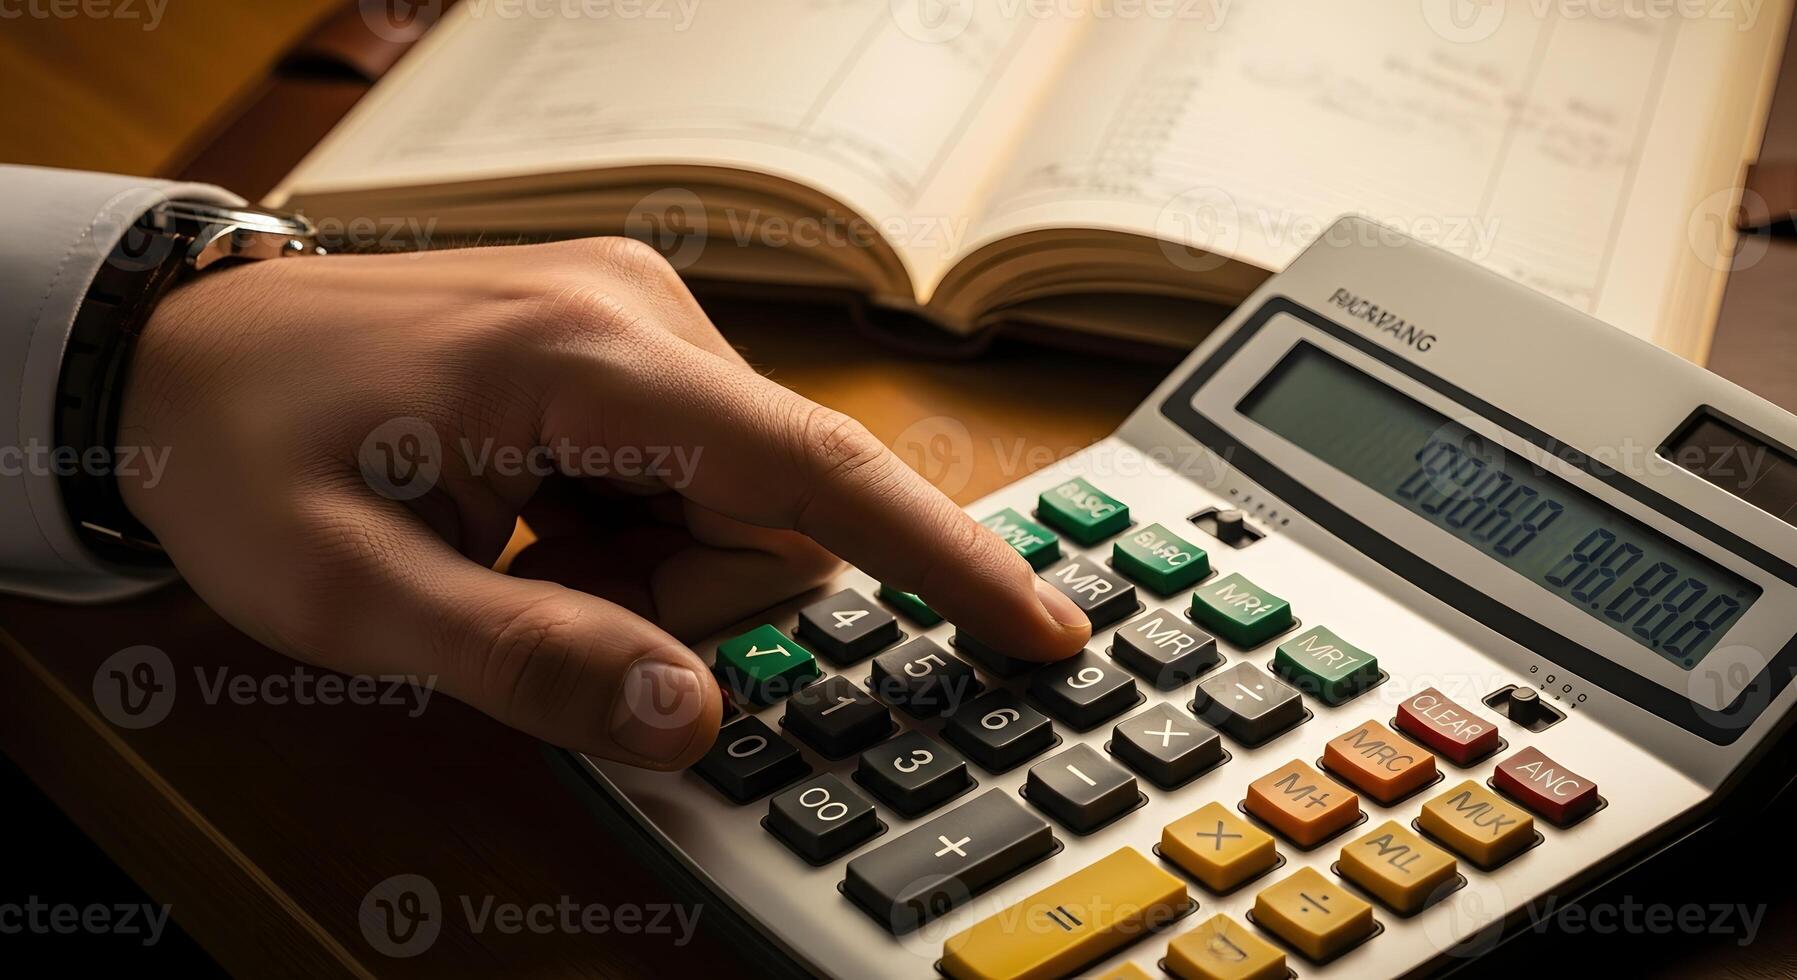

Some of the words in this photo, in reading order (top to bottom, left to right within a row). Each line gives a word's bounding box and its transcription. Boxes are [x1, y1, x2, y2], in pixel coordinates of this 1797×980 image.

[1056, 563, 1113, 601] MR
[831, 609, 870, 629] 4
[1136, 616, 1195, 656] MR
[904, 653, 947, 678] 5
[1067, 667, 1105, 689] 9
[821, 696, 857, 716] 1
[980, 708, 1021, 730] 6
[1412, 695, 1483, 741] CLEAR
[727, 735, 768, 758] 0
[893, 749, 934, 773] 3
[1343, 728, 1414, 772] MRC
[1273, 772, 1330, 809] M+
[1516, 761, 1580, 797] ANC
[799, 787, 848, 821] 00
